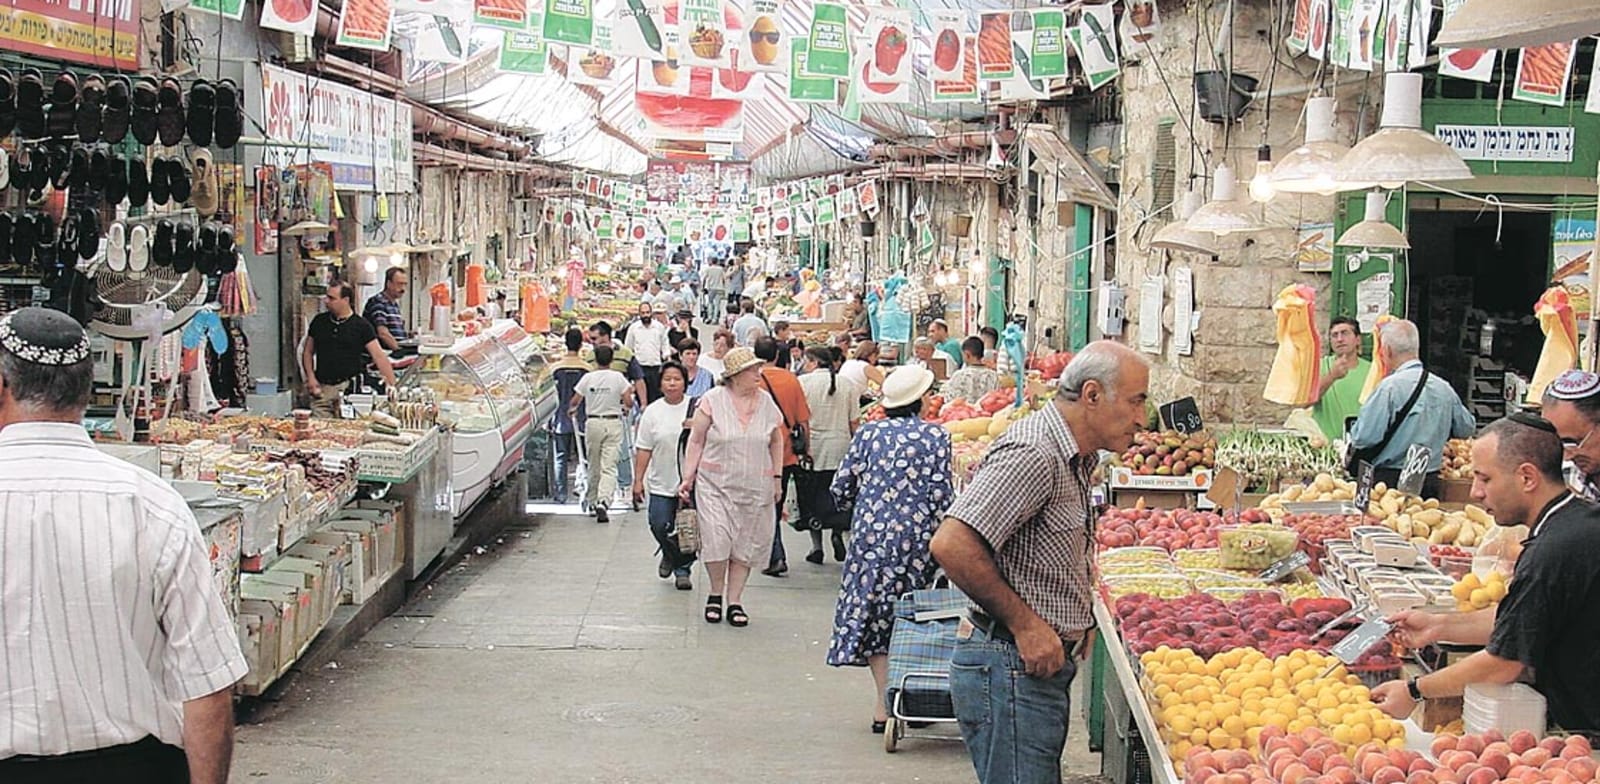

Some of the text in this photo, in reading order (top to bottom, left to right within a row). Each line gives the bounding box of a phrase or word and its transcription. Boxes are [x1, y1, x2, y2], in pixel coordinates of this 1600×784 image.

[19, 18, 47, 40] פירות
[298, 84, 342, 128] המעדנם
[1483, 129, 1511, 157] נחמן
